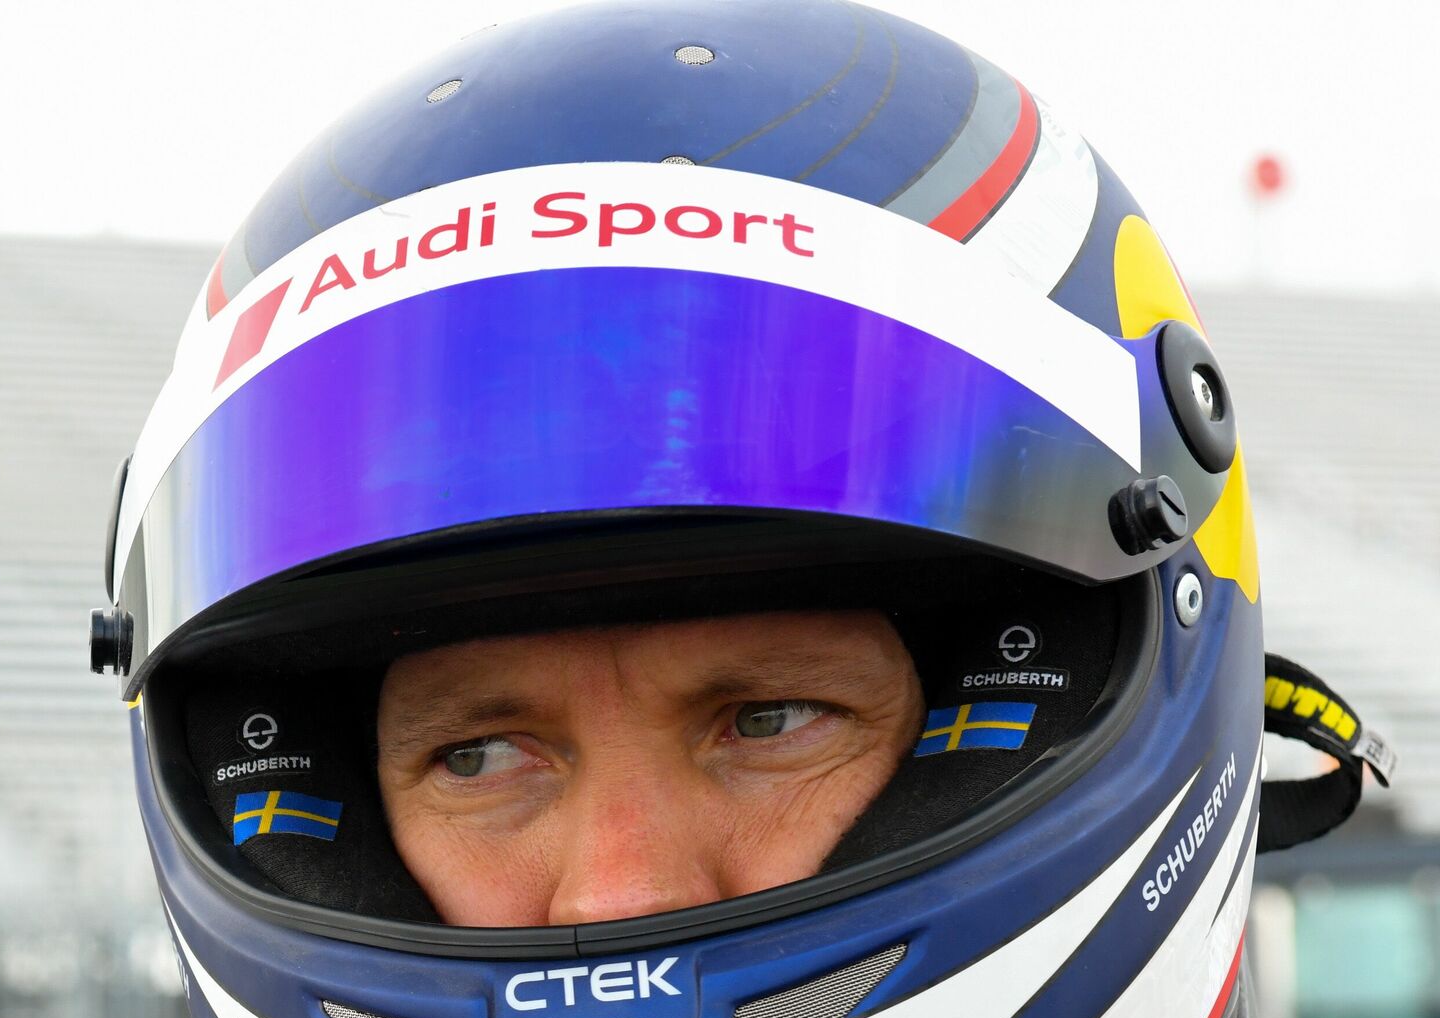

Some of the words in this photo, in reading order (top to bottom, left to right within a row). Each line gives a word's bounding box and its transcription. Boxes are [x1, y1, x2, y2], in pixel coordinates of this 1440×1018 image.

[298, 201, 497, 314] Audi
[531, 191, 815, 258] Sport
[962, 671, 1064, 687] SCHUBERTH
[216, 756, 311, 782] SCHUBERTH
[1142, 752, 1237, 912] SCHUBERTH
[505, 957, 682, 1011] CTEK
